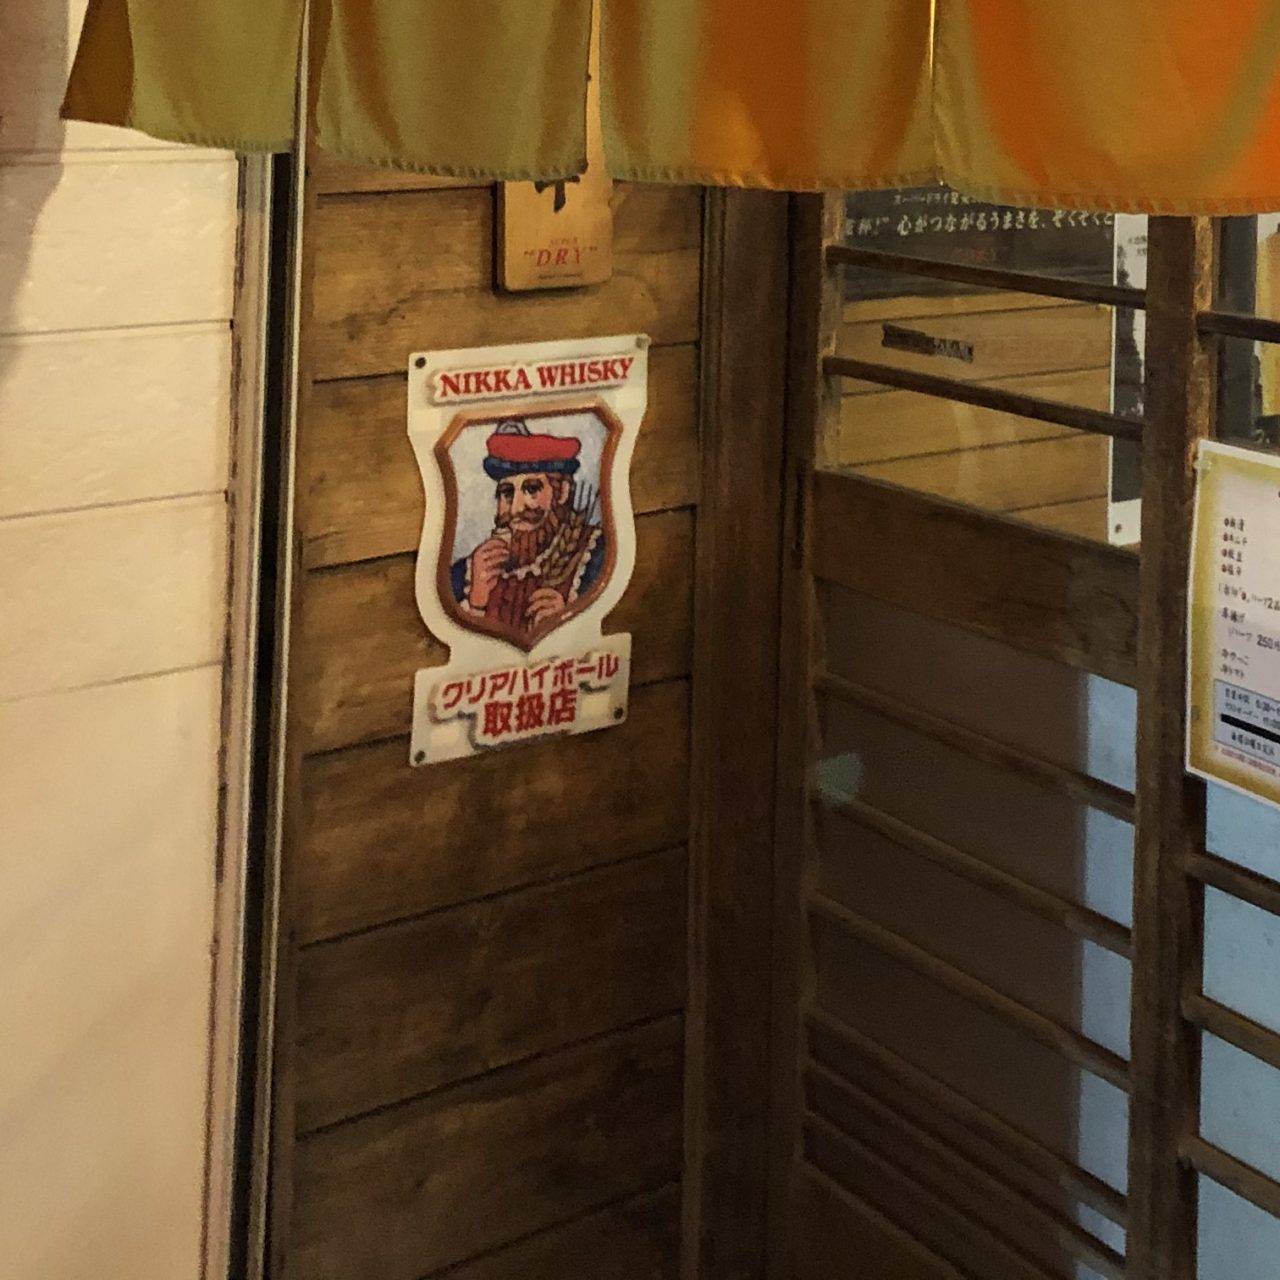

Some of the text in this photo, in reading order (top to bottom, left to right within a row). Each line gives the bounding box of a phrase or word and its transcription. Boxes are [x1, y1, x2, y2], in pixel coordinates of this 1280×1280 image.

[439, 356, 635, 398] NIKKA WHISKY
[441, 652, 620, 710] クリアハイボール
[482, 687, 577, 737] 取扱店
